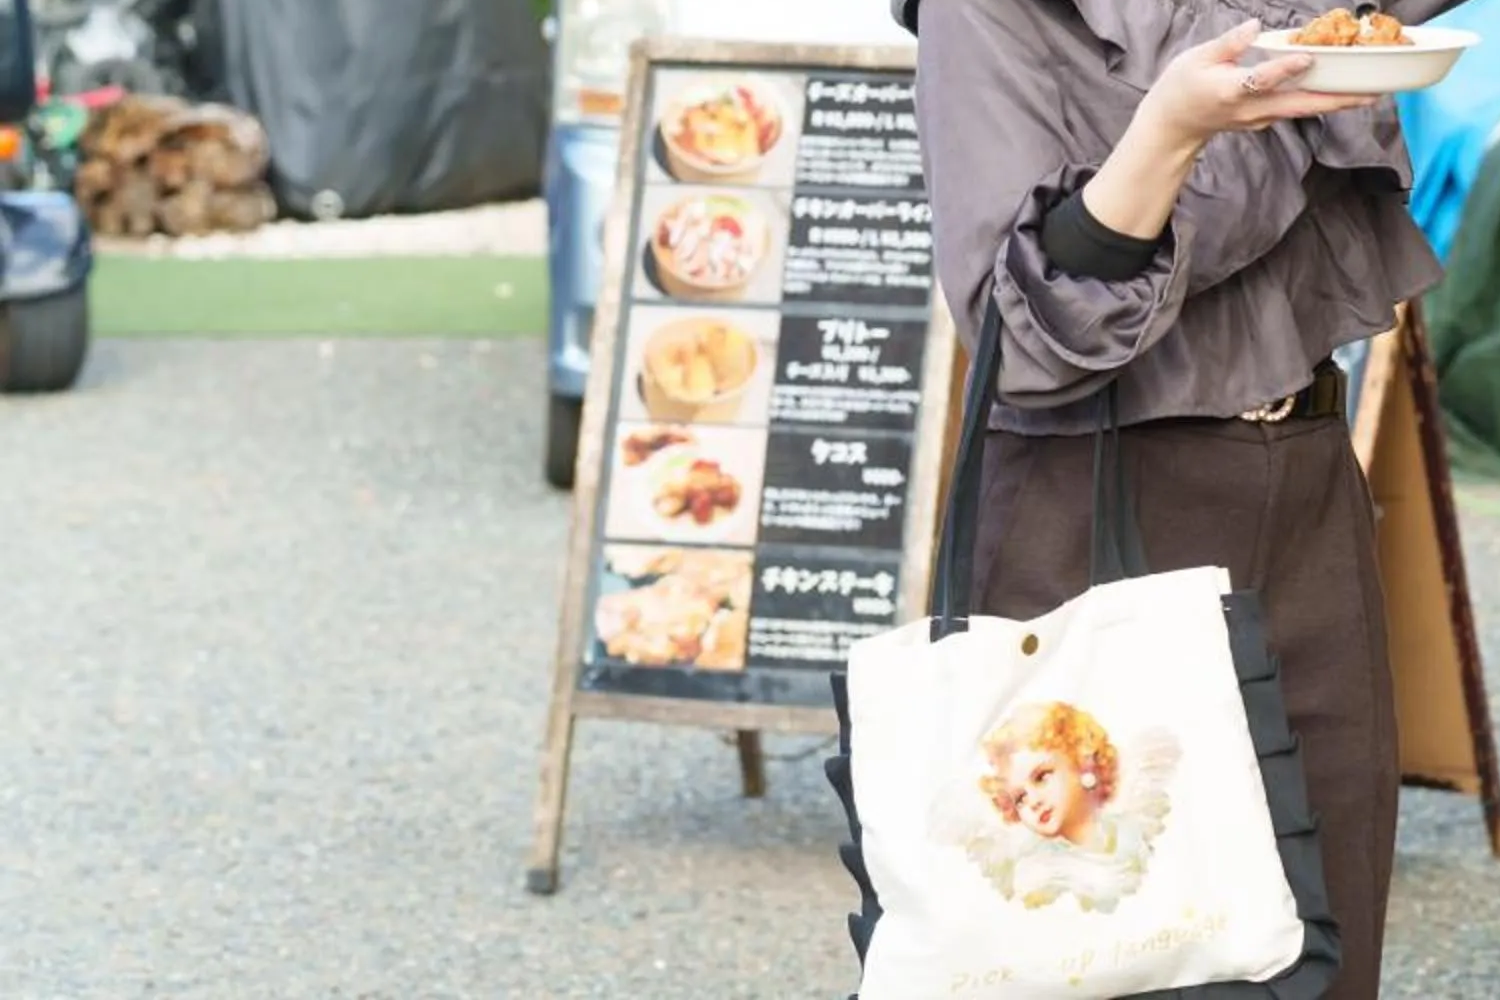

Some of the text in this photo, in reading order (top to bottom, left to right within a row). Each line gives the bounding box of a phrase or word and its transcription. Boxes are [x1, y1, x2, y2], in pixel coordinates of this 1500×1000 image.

[817, 319, 890, 345] ブリトー
[811, 438, 867, 465] タコス
[762, 565, 894, 597] チキンステーキ
